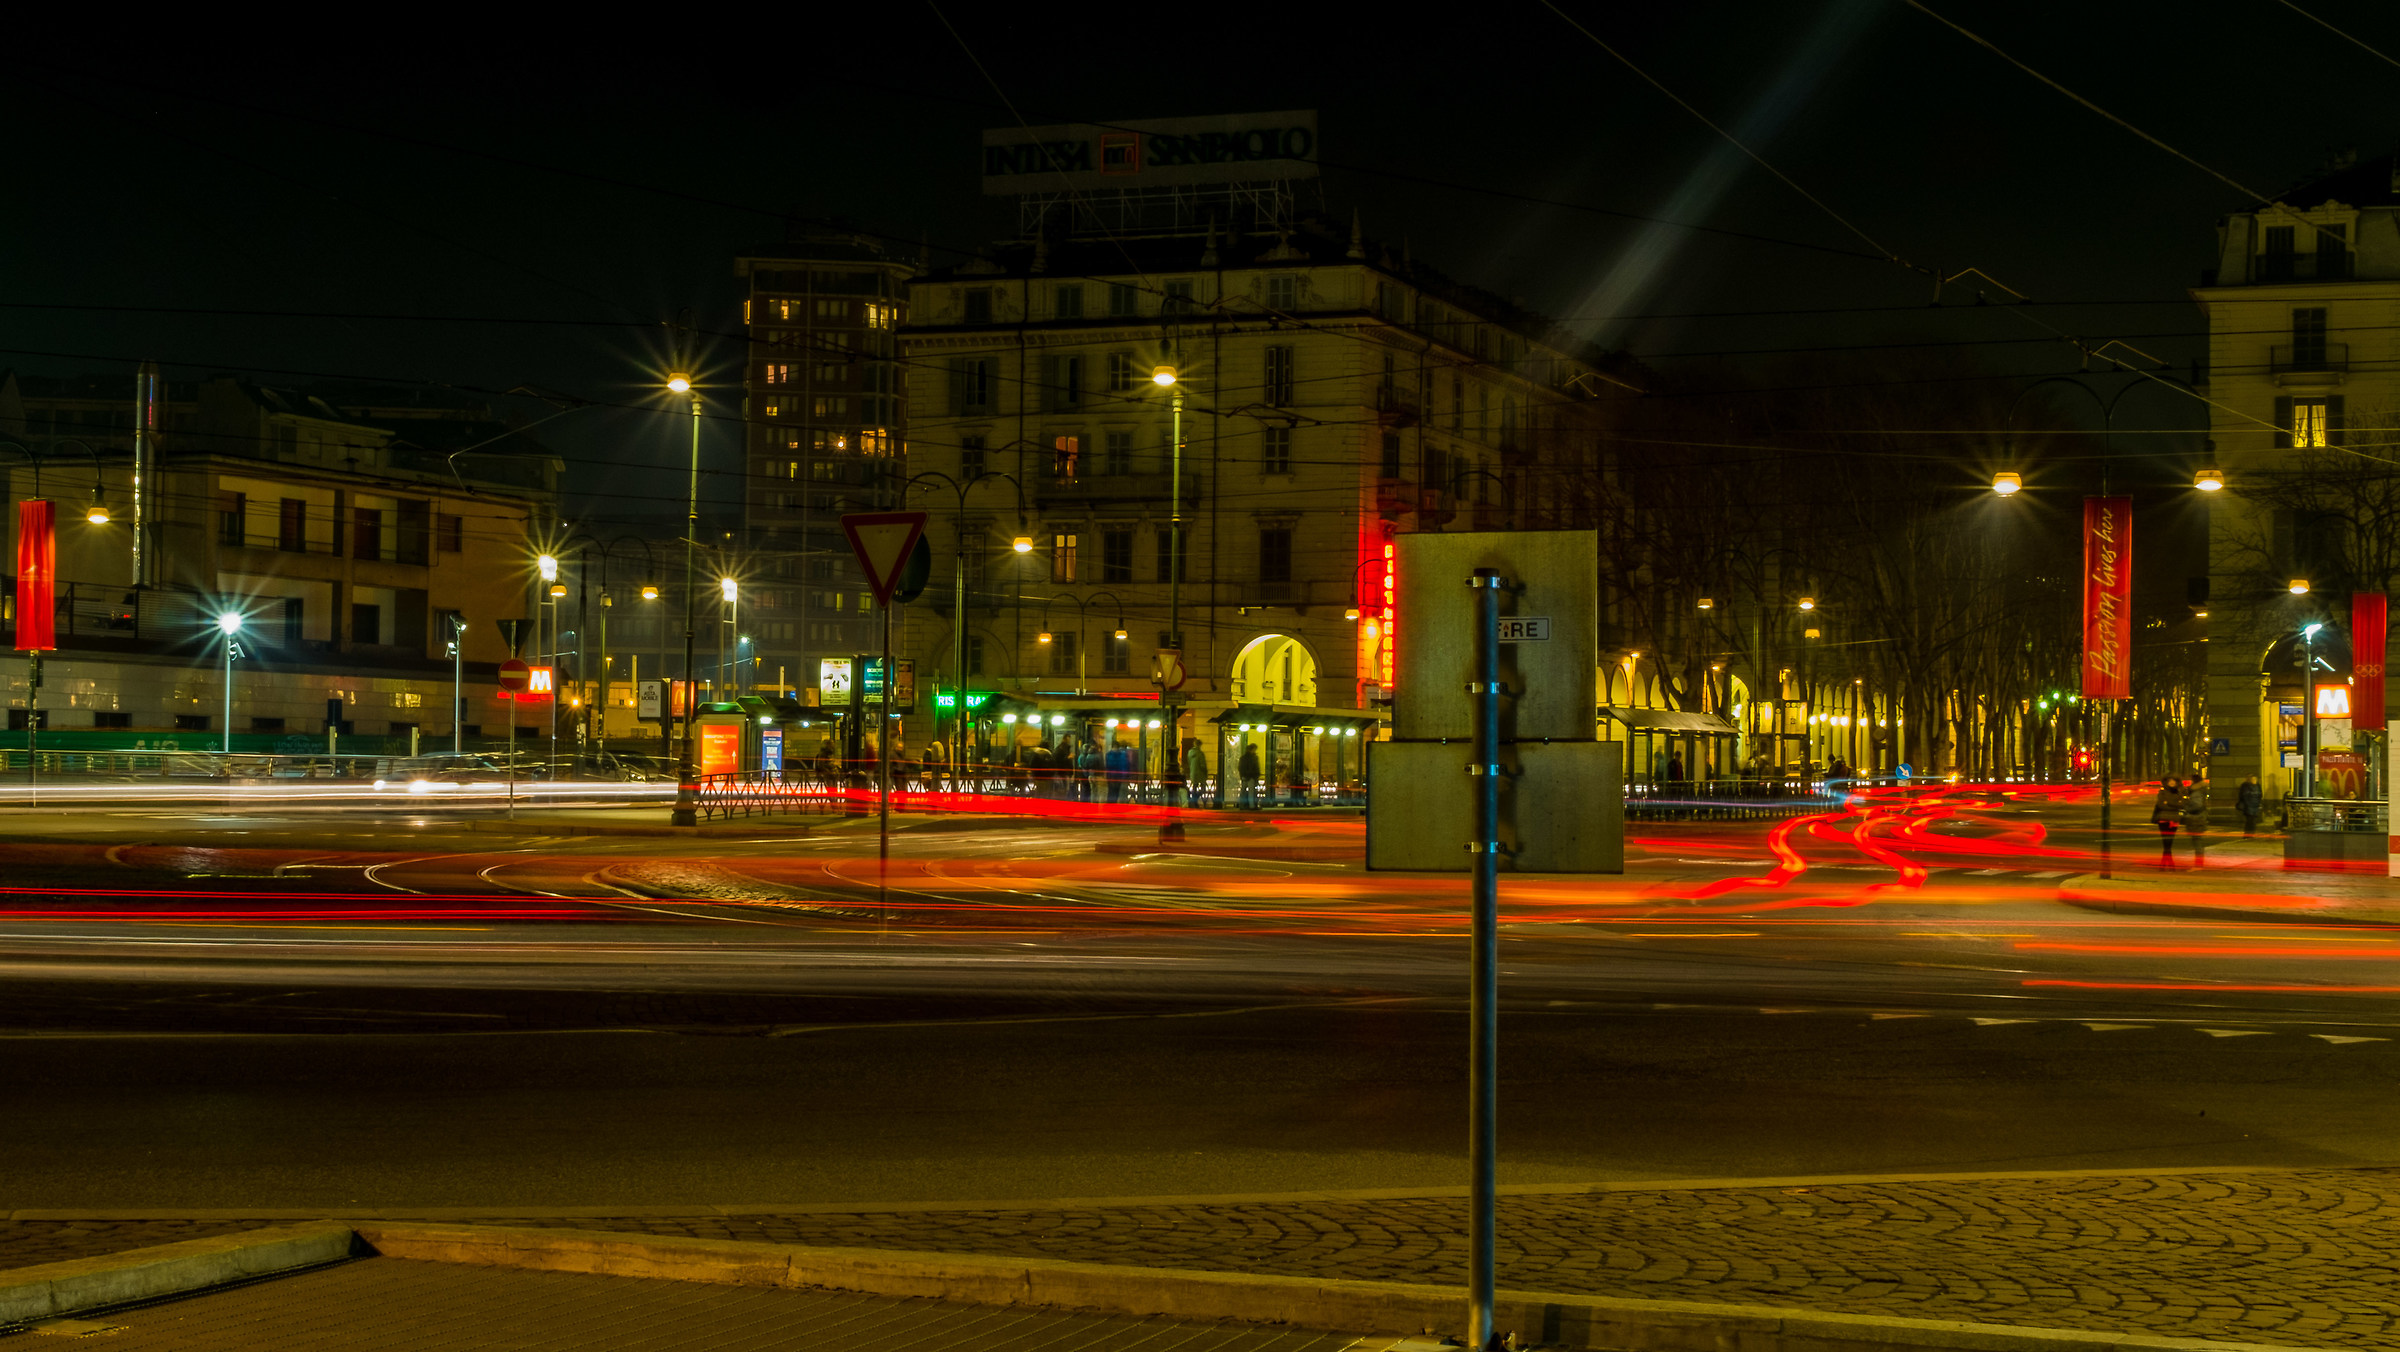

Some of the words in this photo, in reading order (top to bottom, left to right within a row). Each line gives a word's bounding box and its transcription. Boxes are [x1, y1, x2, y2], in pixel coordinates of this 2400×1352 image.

[984, 141, 1091, 175] INTESA
[1147, 127, 1312, 166] SANPAOLO
[2089, 592, 2121, 679] Passion
[530, 671, 551, 690] M
[2316, 689, 2349, 714] M
